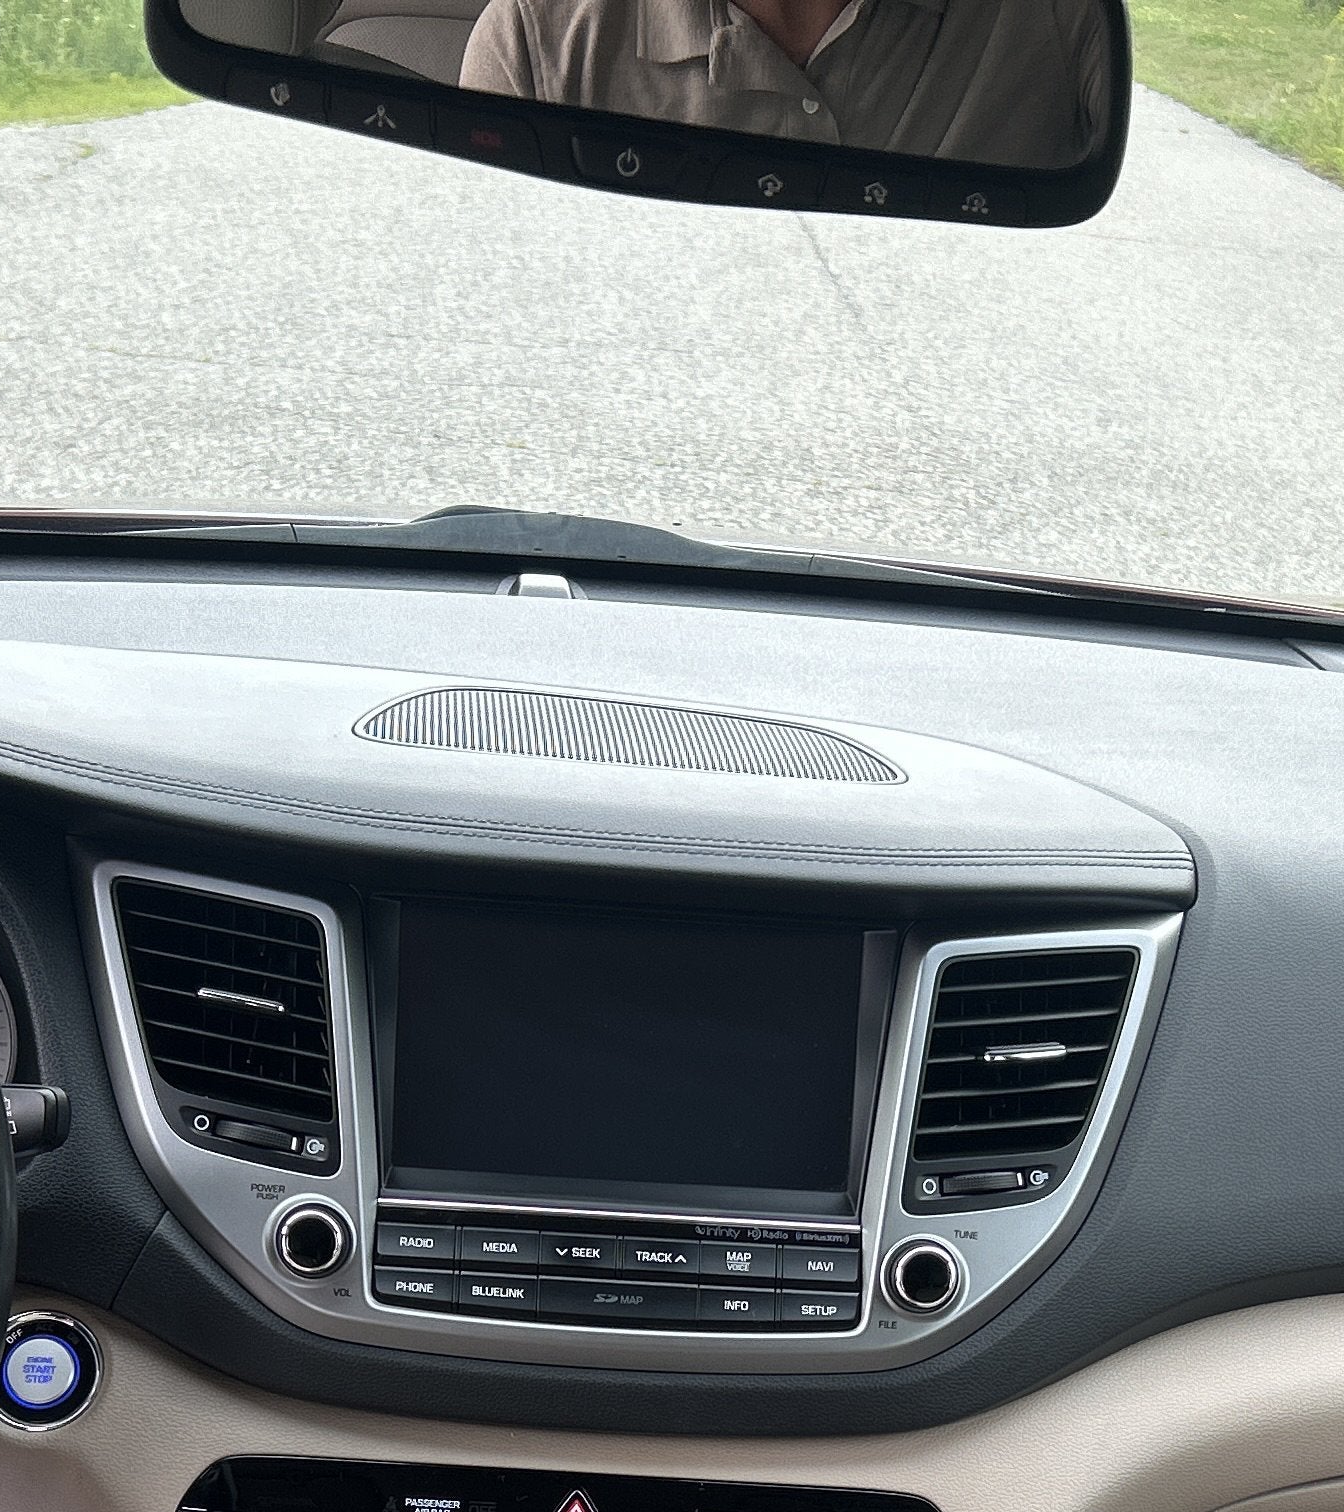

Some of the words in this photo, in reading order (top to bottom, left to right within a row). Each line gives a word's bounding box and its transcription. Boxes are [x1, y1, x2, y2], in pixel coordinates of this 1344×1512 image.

[250, 1183, 285, 1194] POWER
[762, 1230, 789, 1240] Radio
[953, 1230, 978, 1240] TUNE
[399, 1236, 434, 1249] RADIO
[482, 1242, 518, 1253] MEDIA
[572, 1247, 600, 1259] SEEK
[635, 1251, 673, 1263] TRACK
[726, 1251, 752, 1262] MAP
[726, 1262, 751, 1272] VOICE
[807, 1260, 834, 1272] NAVI
[333, 1288, 352, 1297] VOL
[395, 1281, 434, 1294] PHONE
[471, 1286, 525, 1299] BLUELINK
[620, 1295, 644, 1305] MAP
[724, 1299, 749, 1311] INFO
[801, 1304, 837, 1316] SETUP
[878, 1320, 897, 1330] FILE
[5, 1328, 24, 1344] OFF
[23, 1365, 56, 1375] START
[25, 1375, 53, 1384] STOP
[405, 1498, 461, 1509] PASSENGER
